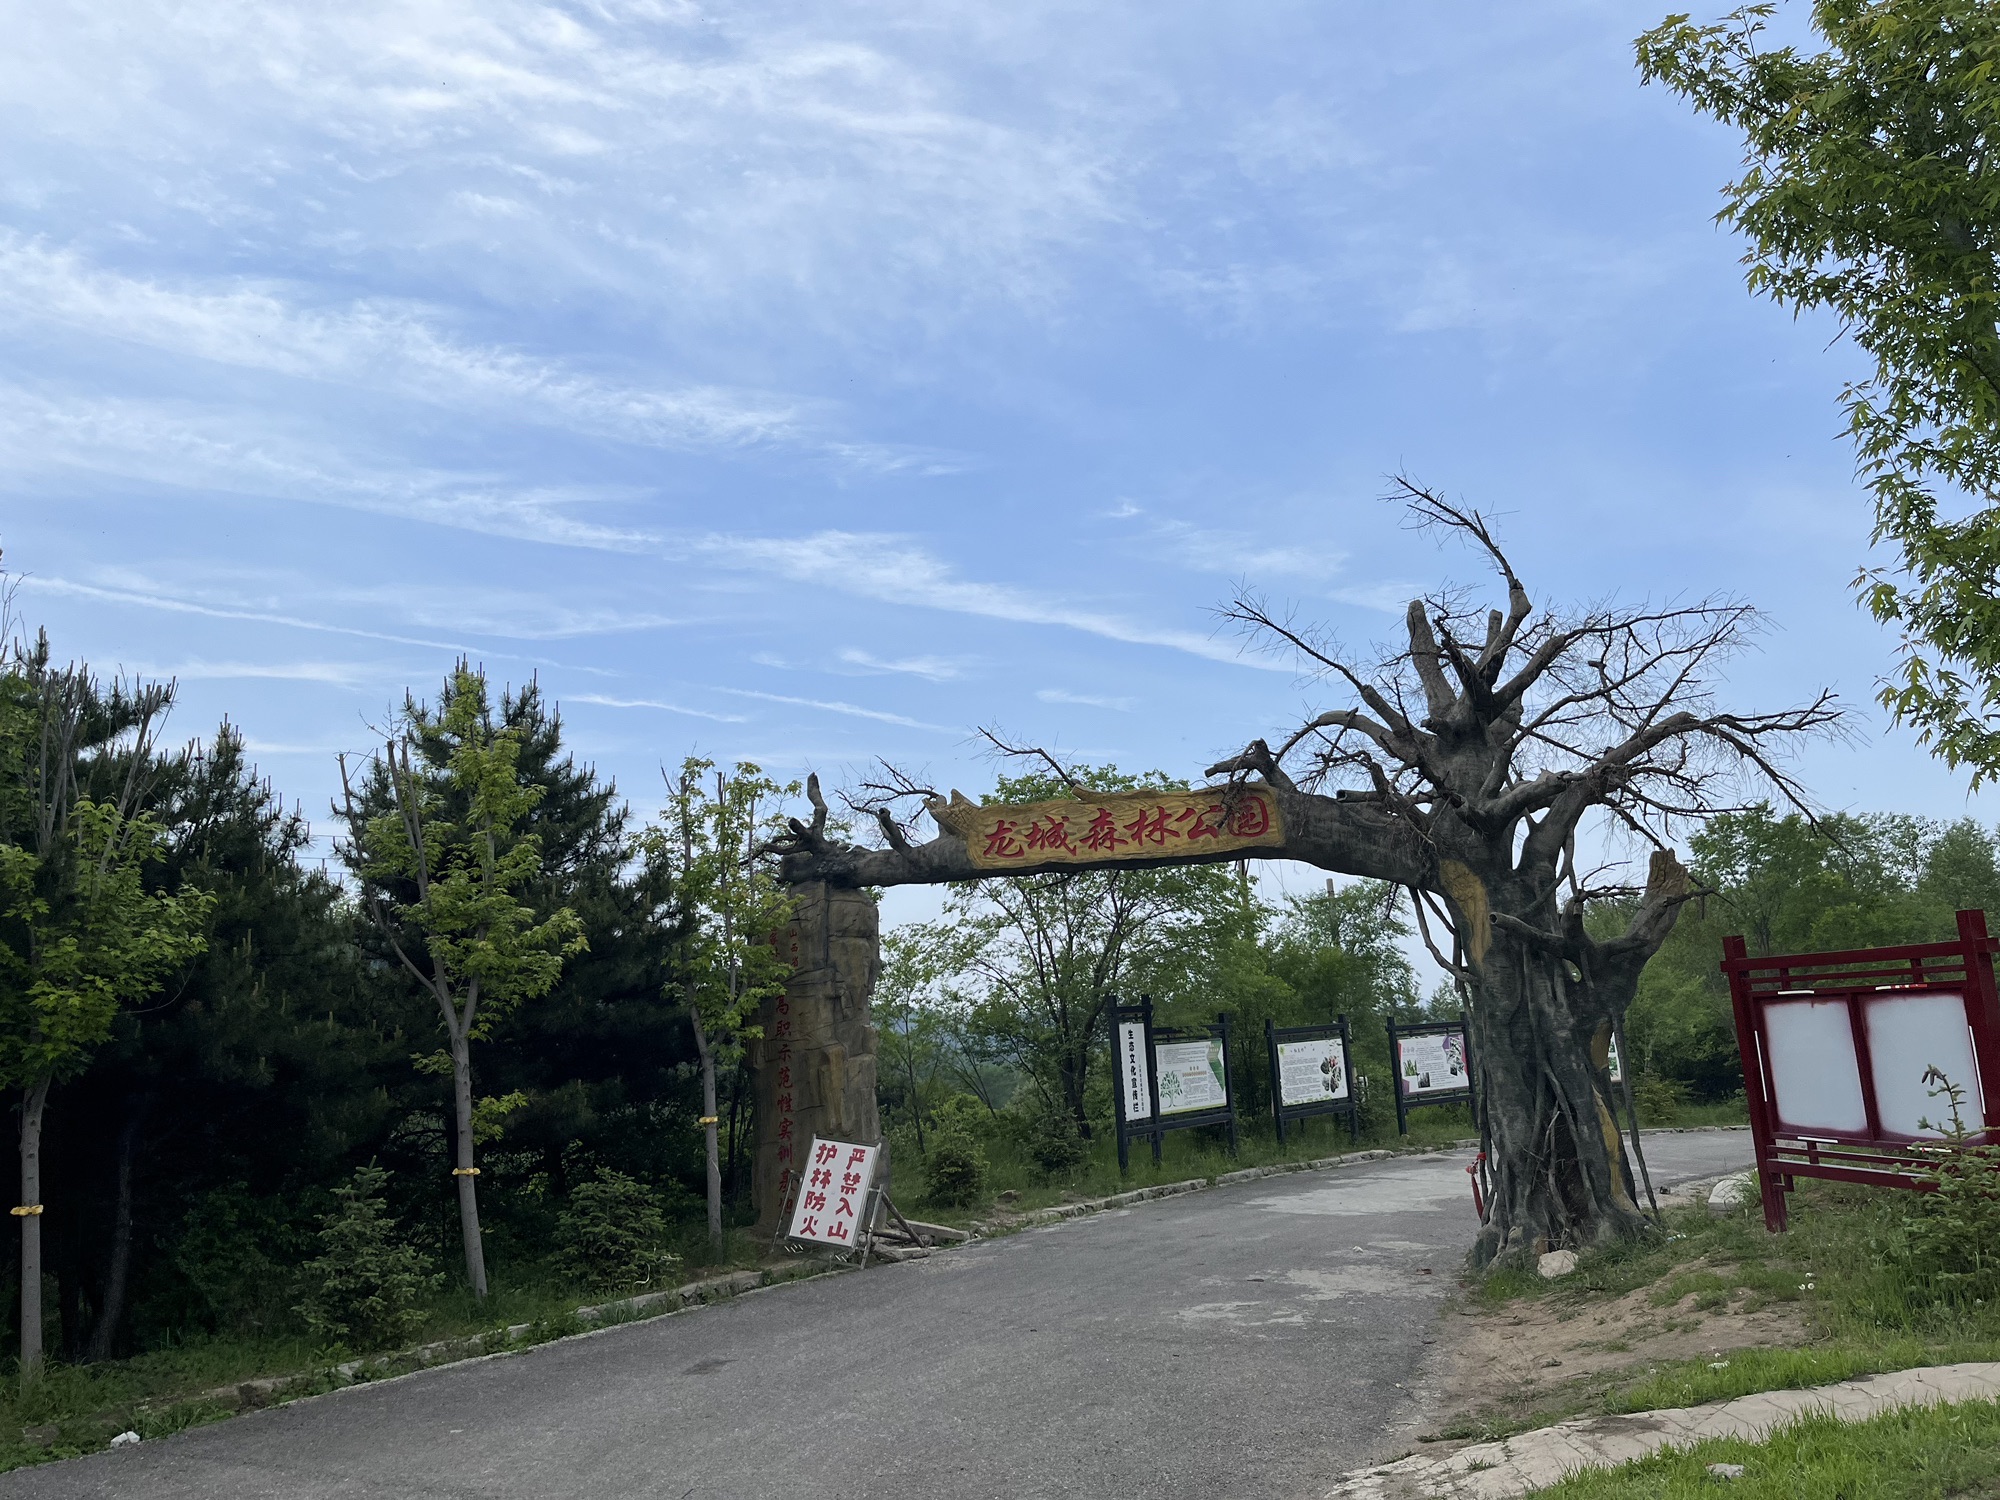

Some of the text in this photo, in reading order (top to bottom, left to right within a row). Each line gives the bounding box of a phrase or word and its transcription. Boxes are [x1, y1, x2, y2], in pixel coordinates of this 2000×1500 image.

[1128, 1030, 1139, 1112] 生态文化宣传栏
[800, 1143, 838, 1237] 护林防火
[827, 1148, 866, 1240] 严禁入山
